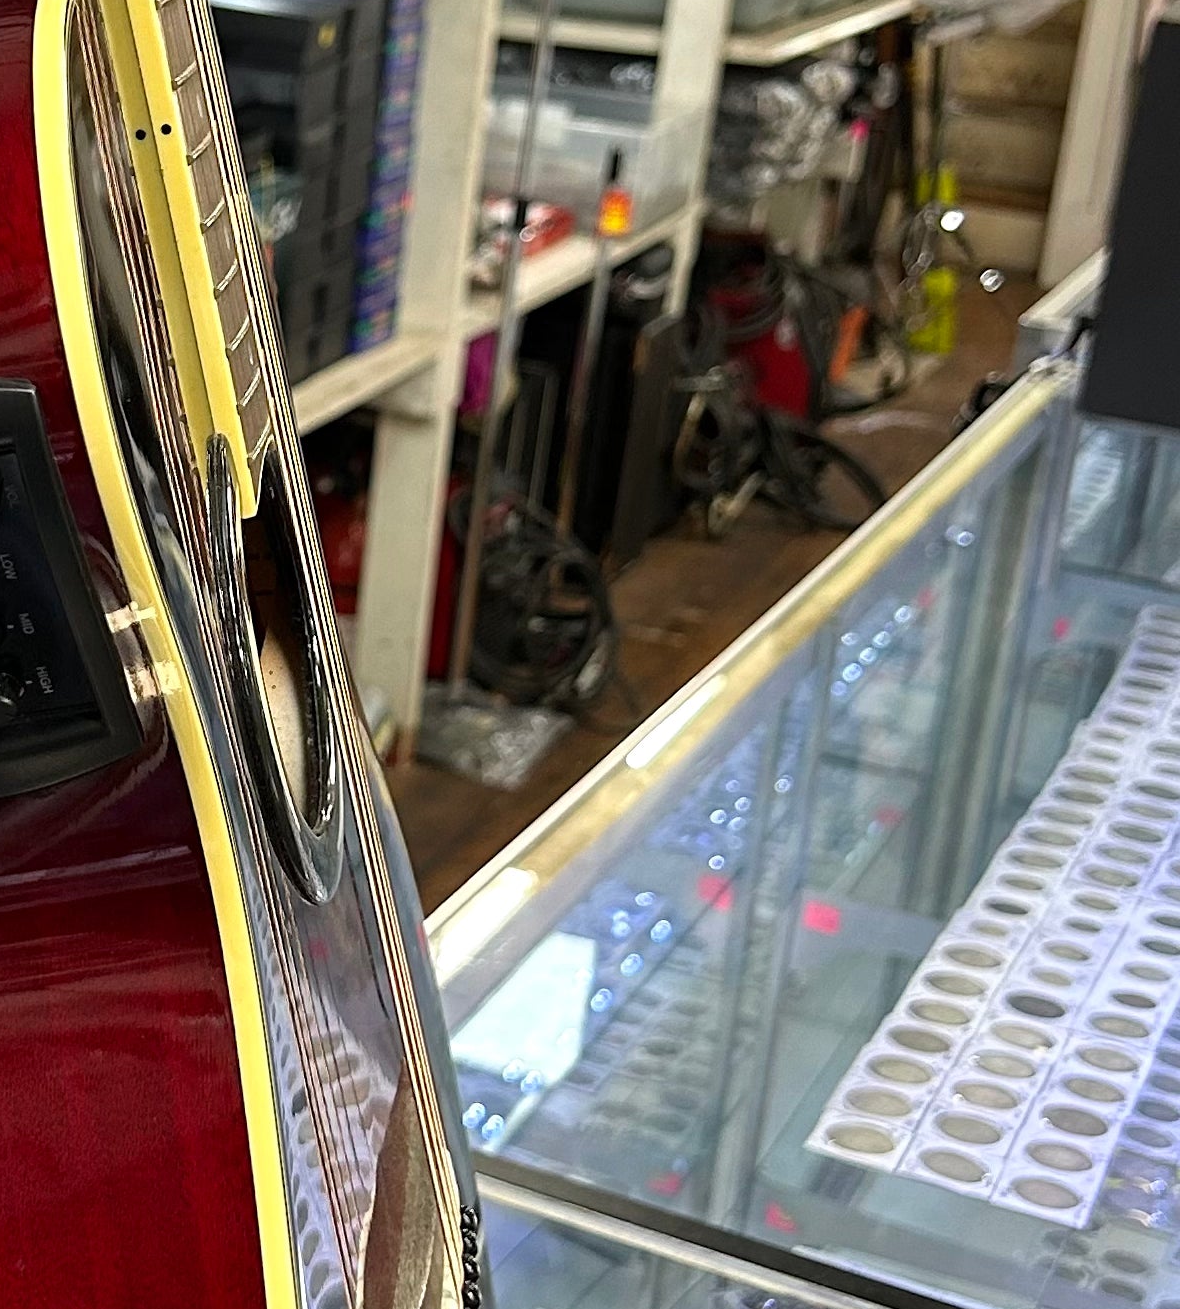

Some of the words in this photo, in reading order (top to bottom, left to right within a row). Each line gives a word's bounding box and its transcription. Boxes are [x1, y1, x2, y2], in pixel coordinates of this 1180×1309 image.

[0, 553, 18, 580] LOW
[19, 612, 35, 635] MID
[36, 665, 54, 694] HIGH
